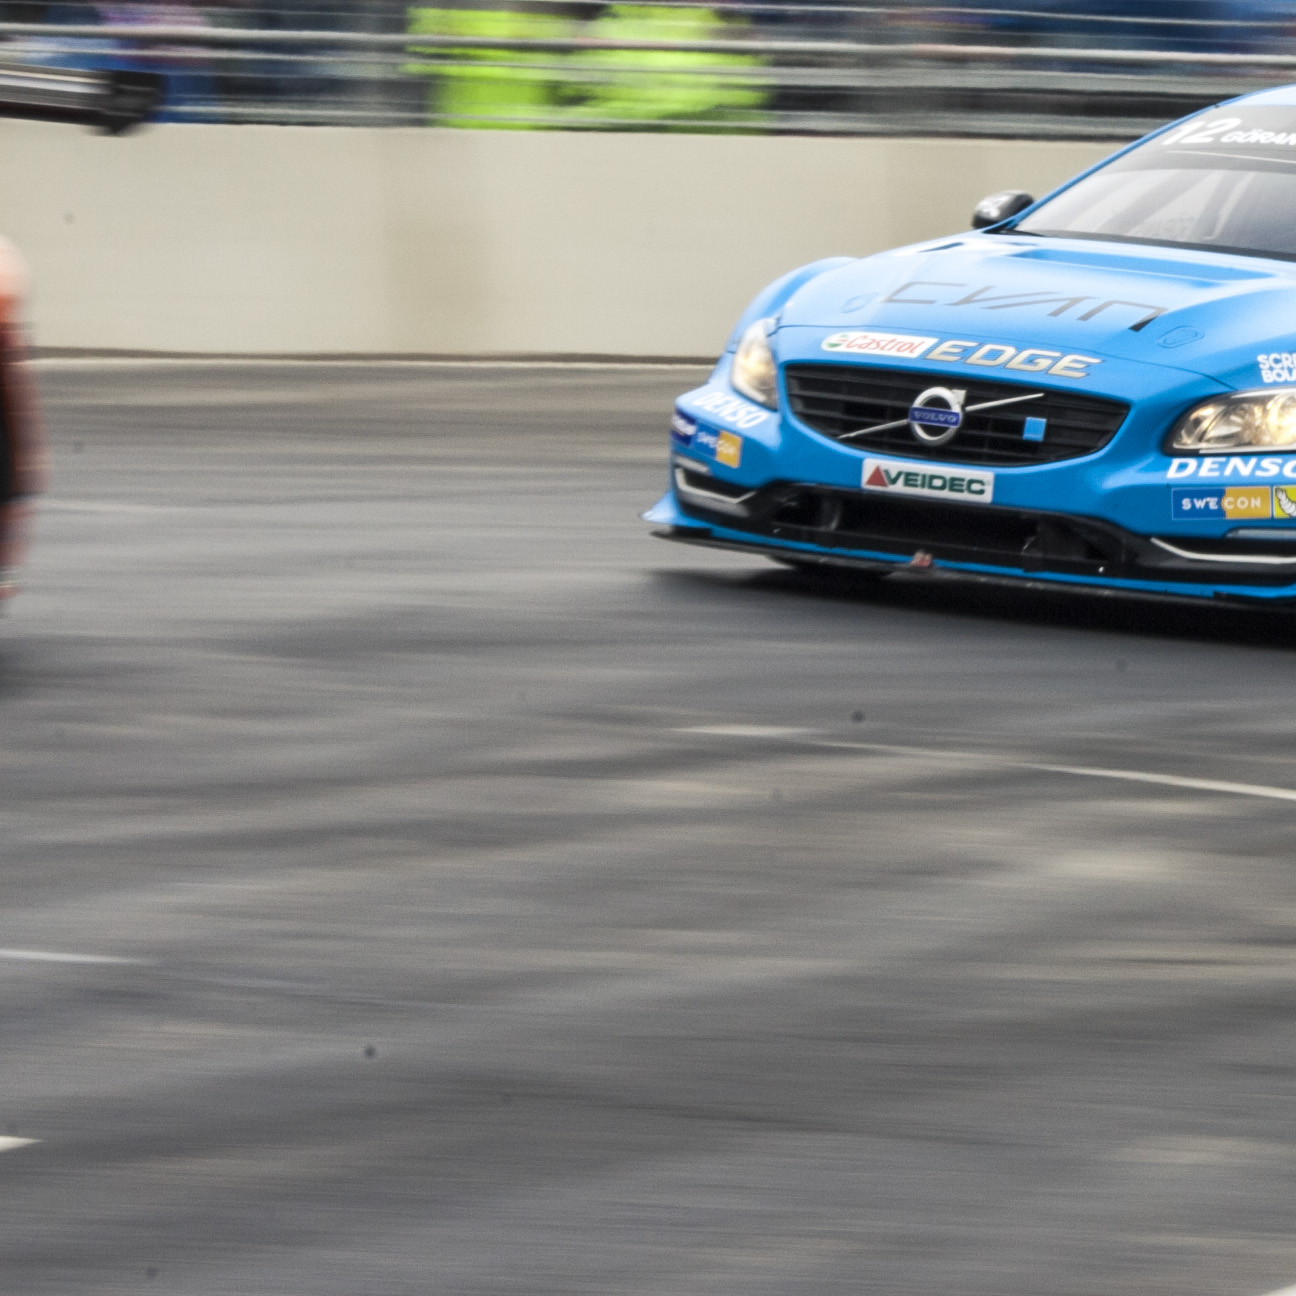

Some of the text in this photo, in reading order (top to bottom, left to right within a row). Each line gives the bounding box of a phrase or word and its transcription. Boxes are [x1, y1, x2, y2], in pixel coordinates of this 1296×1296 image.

[1162, 117, 1242, 146] 12
[846, 334, 1104, 379] Castrol EDGE
[912, 409, 958, 425] VOLVO
[884, 468, 987, 496] VEIDEC
